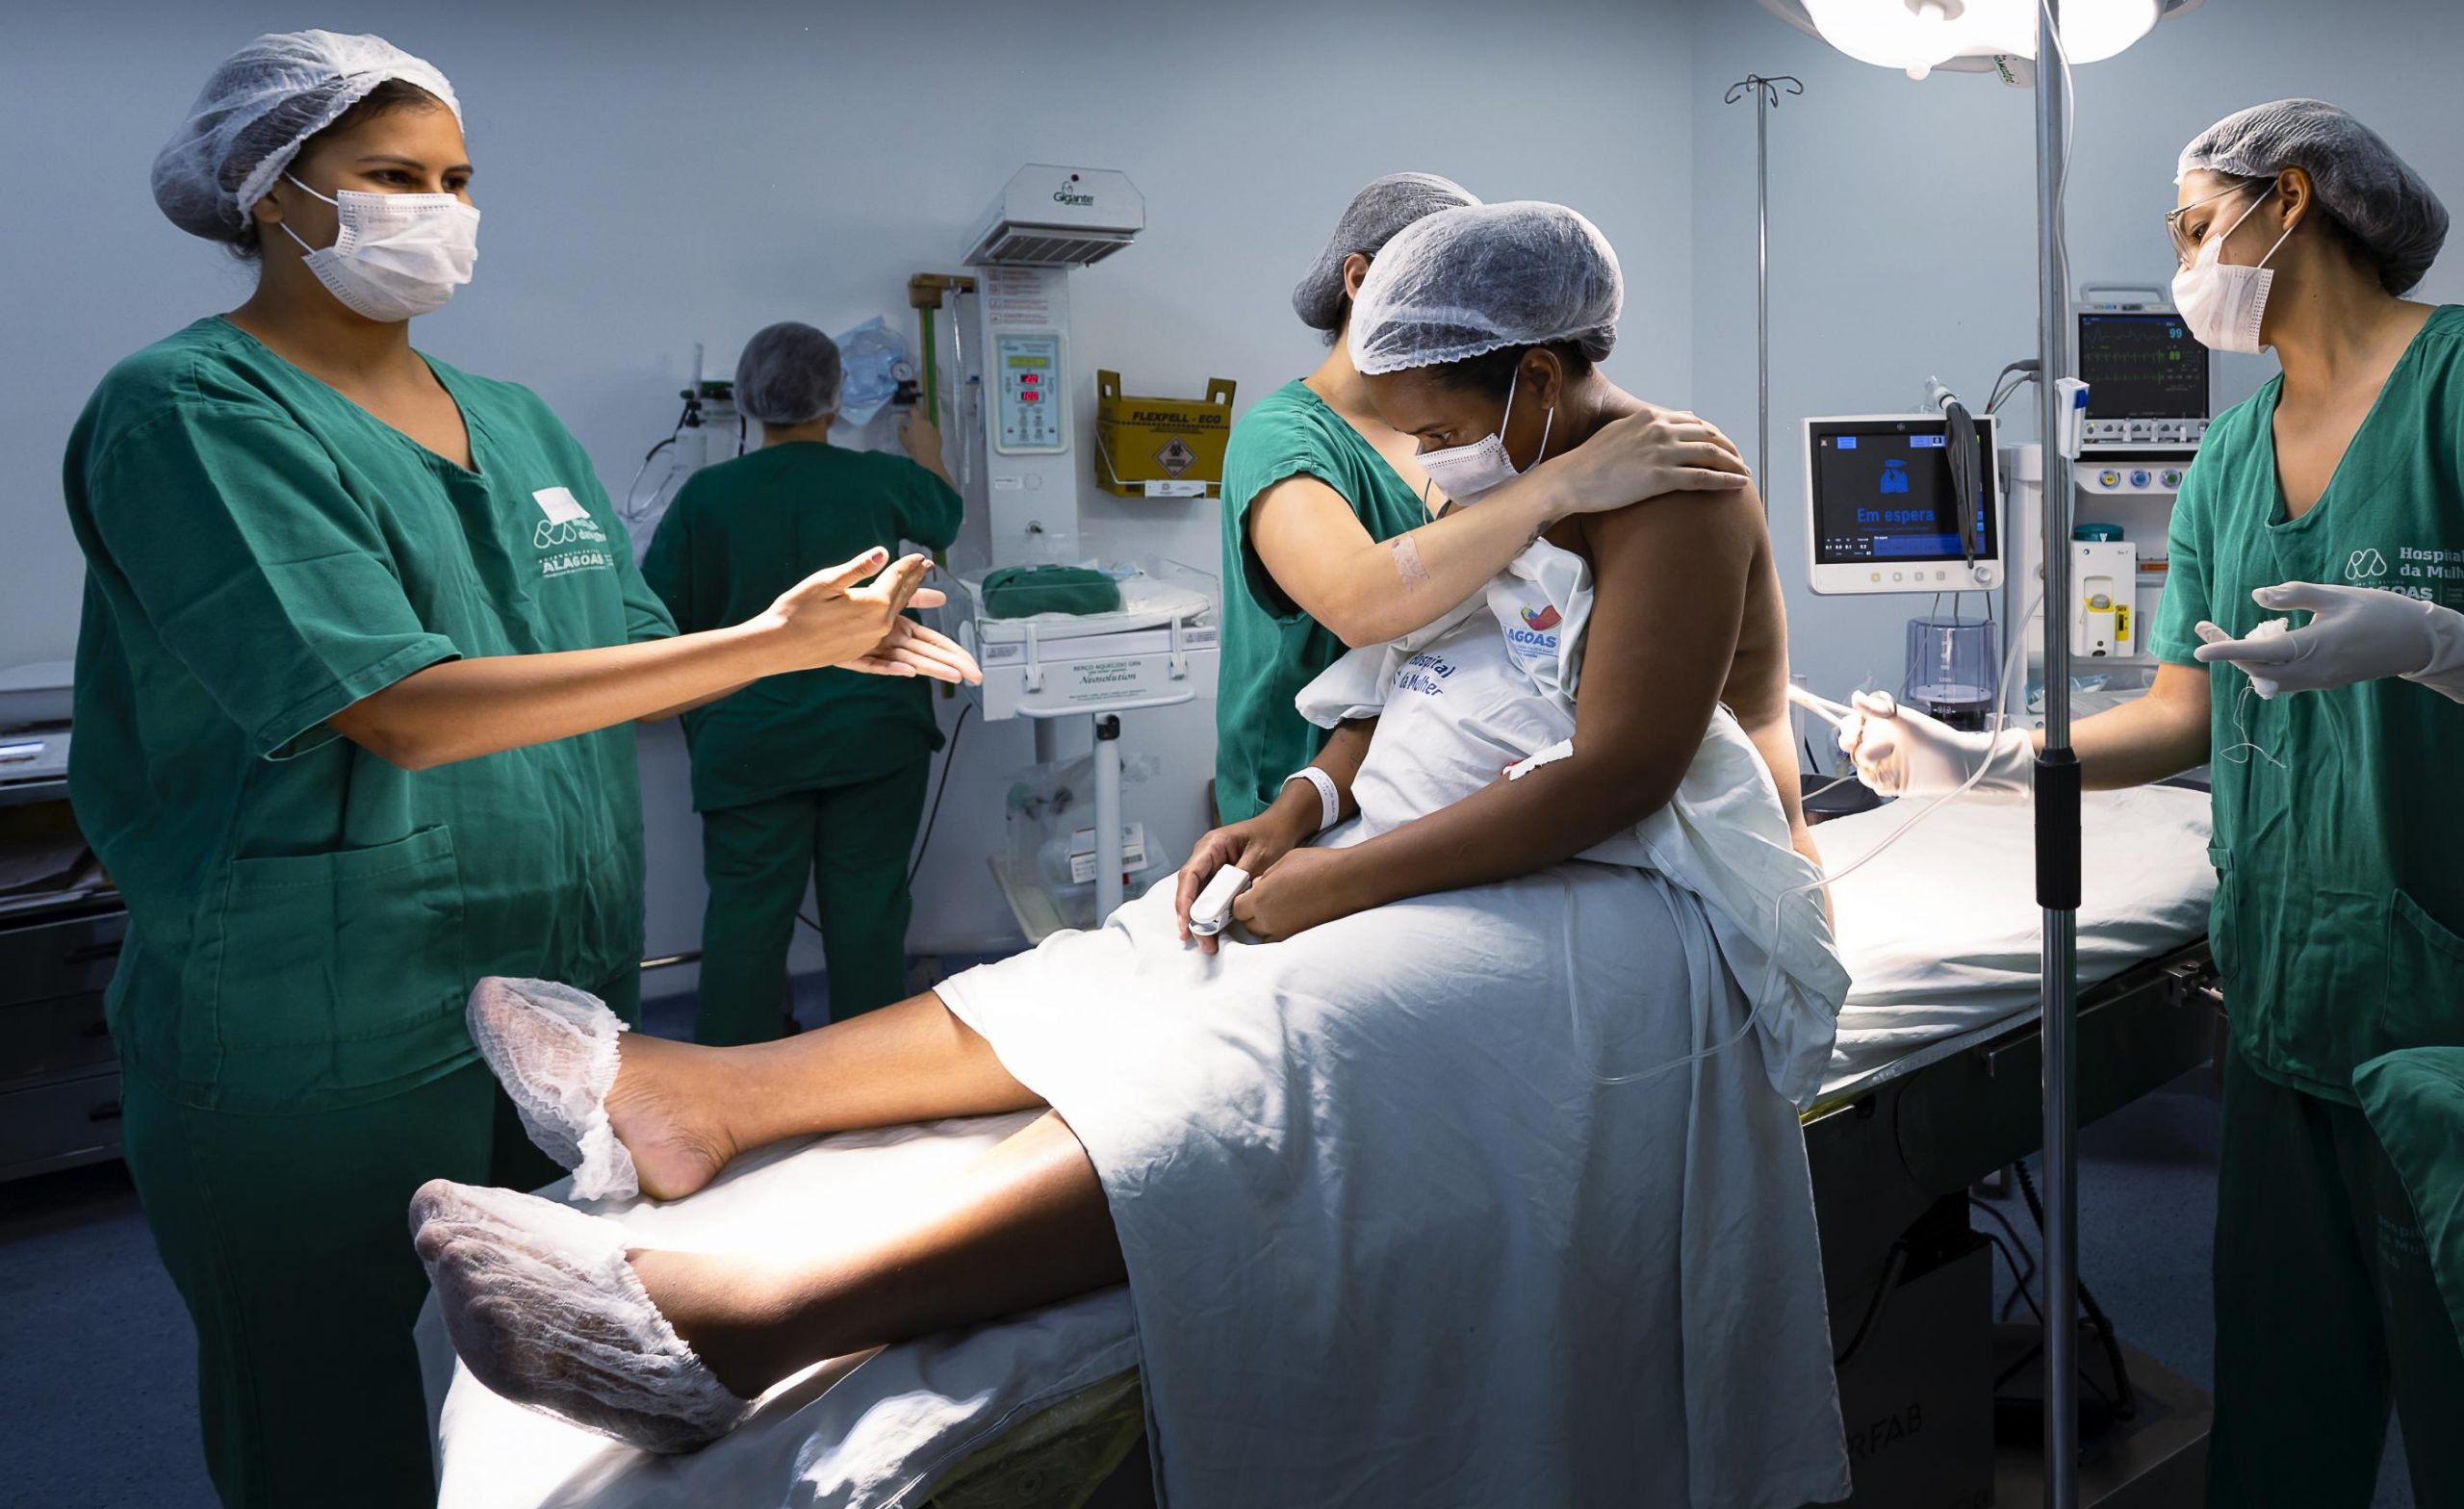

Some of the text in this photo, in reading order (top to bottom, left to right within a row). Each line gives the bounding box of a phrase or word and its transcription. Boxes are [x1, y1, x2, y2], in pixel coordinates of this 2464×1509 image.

[1053, 192, 1093, 205] Gigante
[2169, 328, 2183, 339] 99
[1198, 414, 1221, 423] ECO
[1857, 508, 1934, 524] Em espera
[542, 554, 603, 574] ALAGOAS
[2400, 564, 2421, 576] da
[1079, 673, 1136, 684] Neosolution
